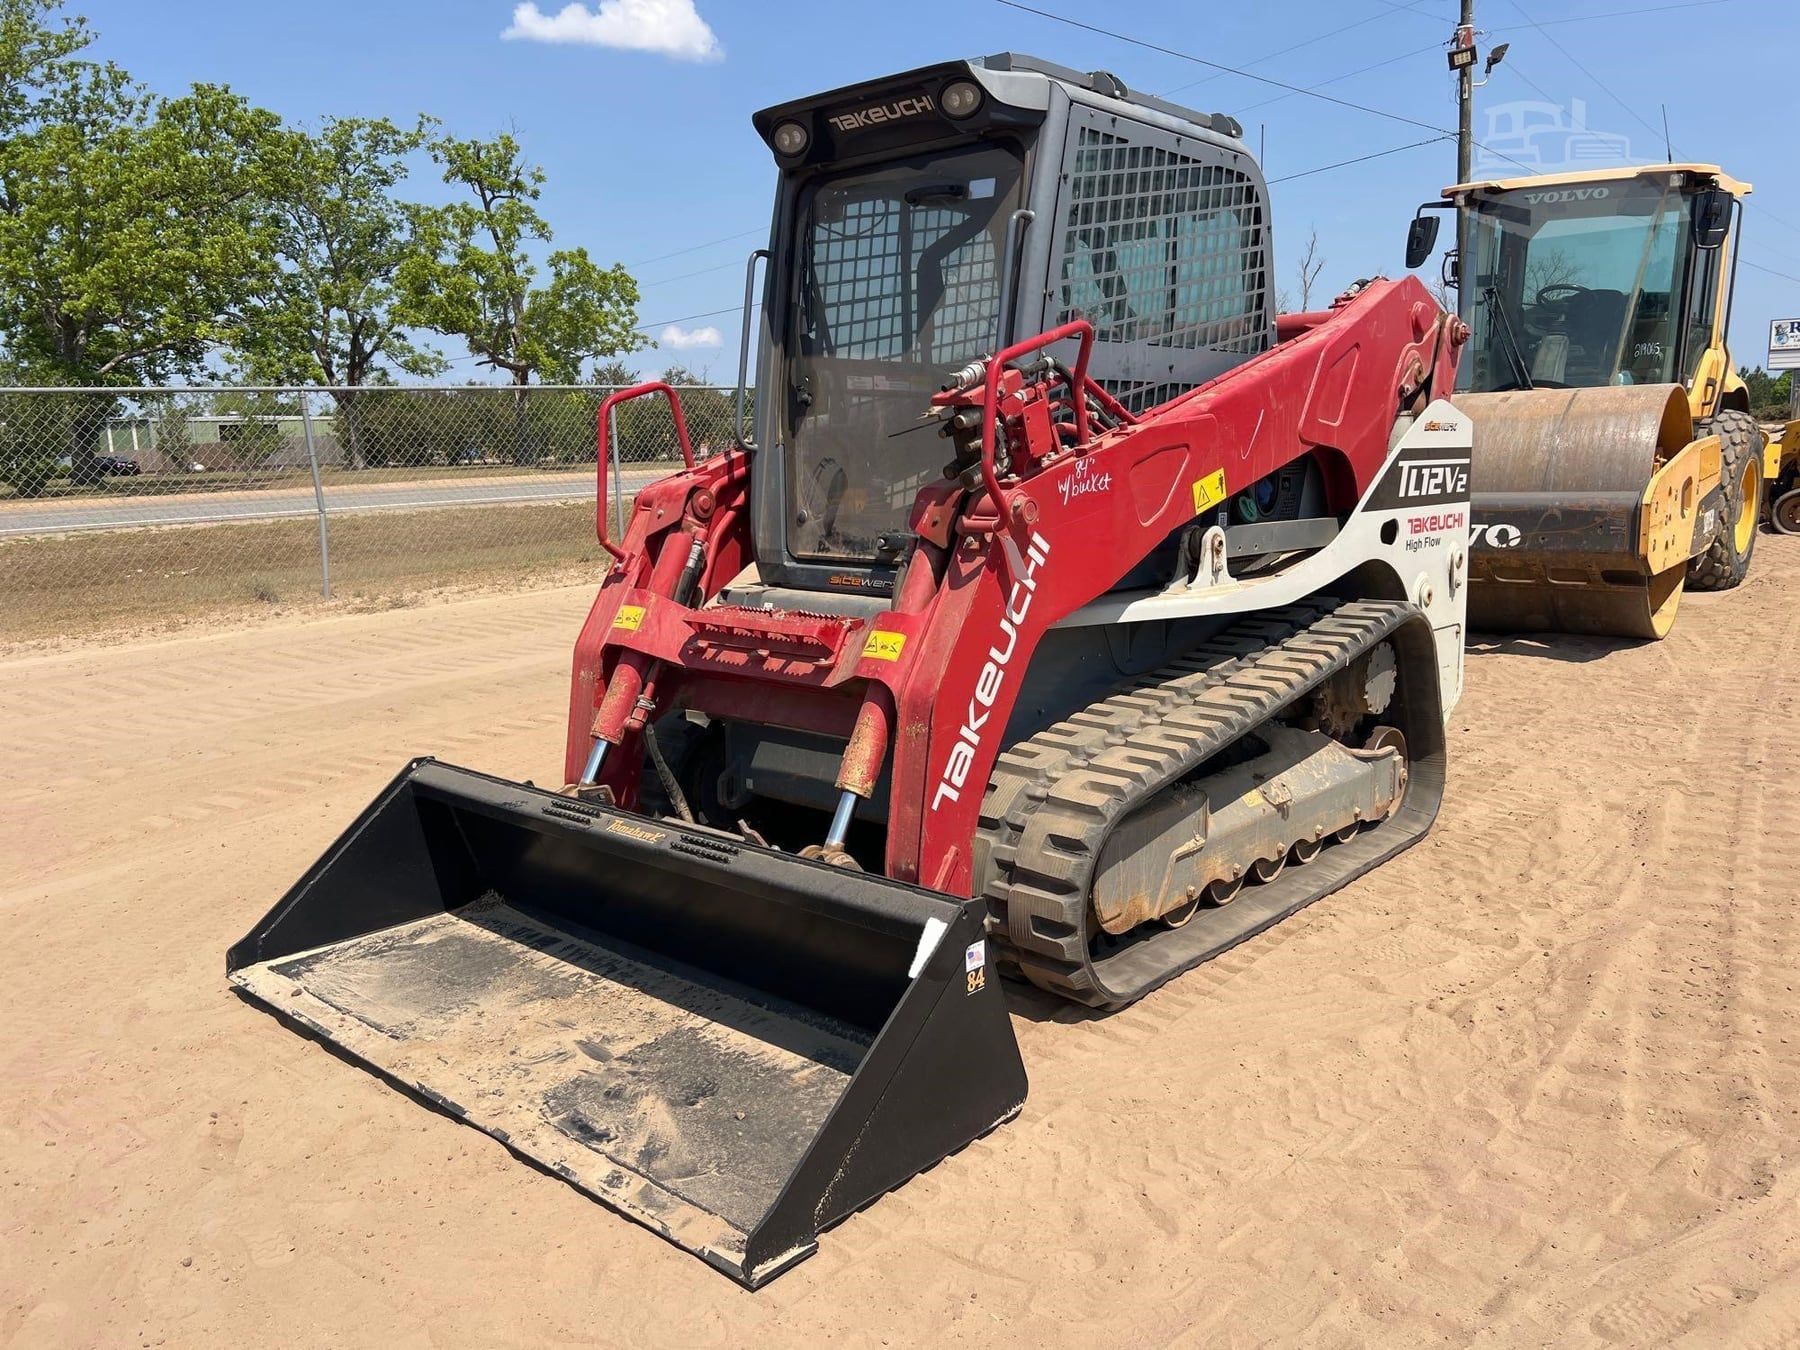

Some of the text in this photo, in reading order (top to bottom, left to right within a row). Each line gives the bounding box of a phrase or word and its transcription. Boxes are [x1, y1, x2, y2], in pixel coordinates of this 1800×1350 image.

[1525, 187, 1609, 205] VOLVO
[1405, 537, 1441, 552] High Flow
[966, 966, 985, 992] 84
